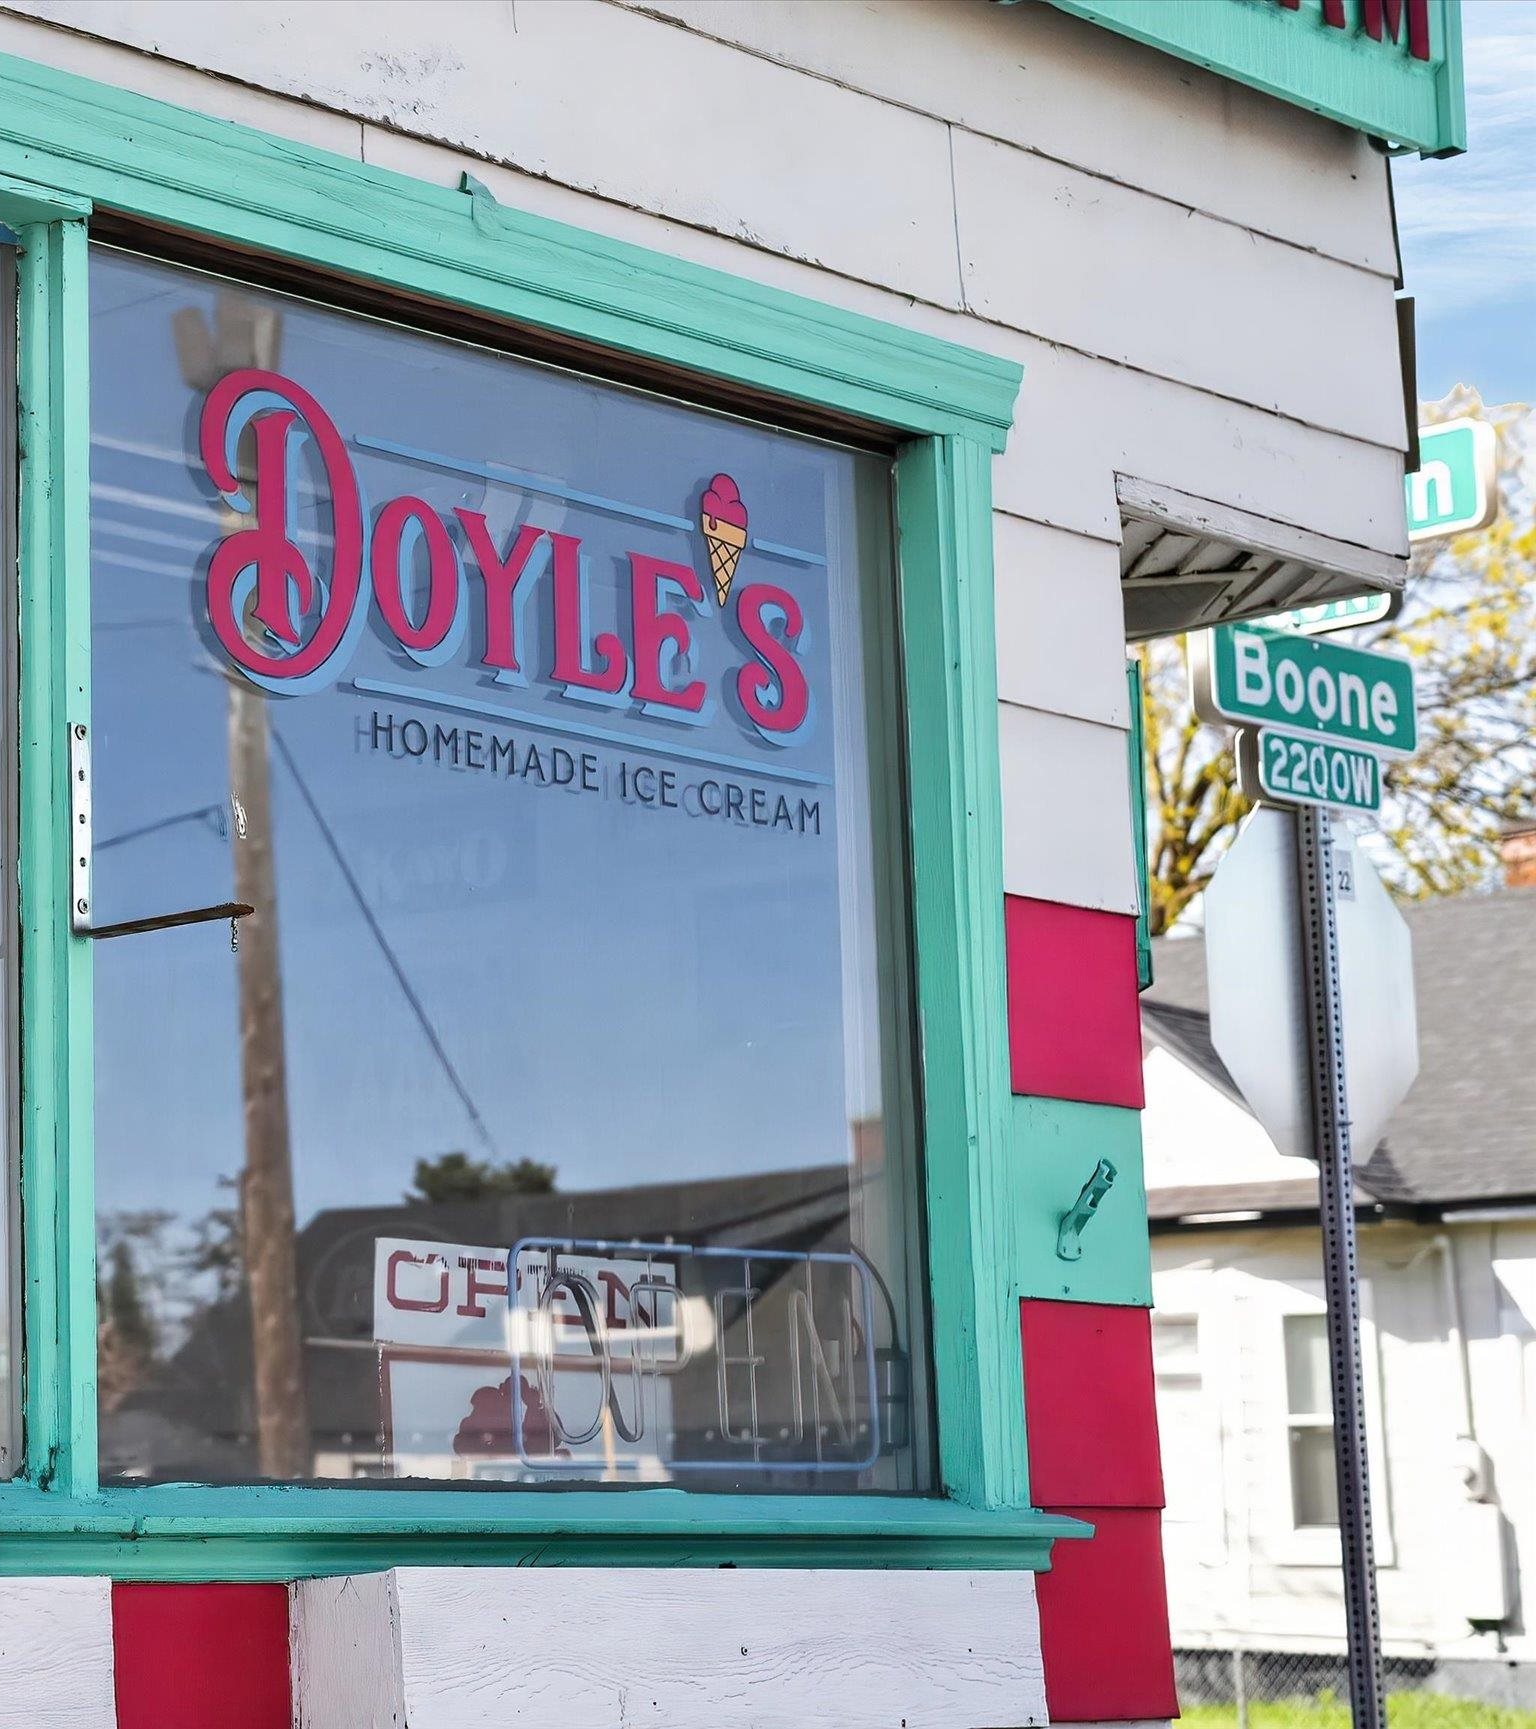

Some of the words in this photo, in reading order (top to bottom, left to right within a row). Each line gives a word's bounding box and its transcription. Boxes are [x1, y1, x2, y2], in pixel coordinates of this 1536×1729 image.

[1233, 630, 1399, 736] Boone
[370, 710, 599, 792] HOMEMADE
[618, 761, 677, 807] ICE
[697, 780, 821, 835] CREAM
[1269, 743, 1374, 806] 2200W
